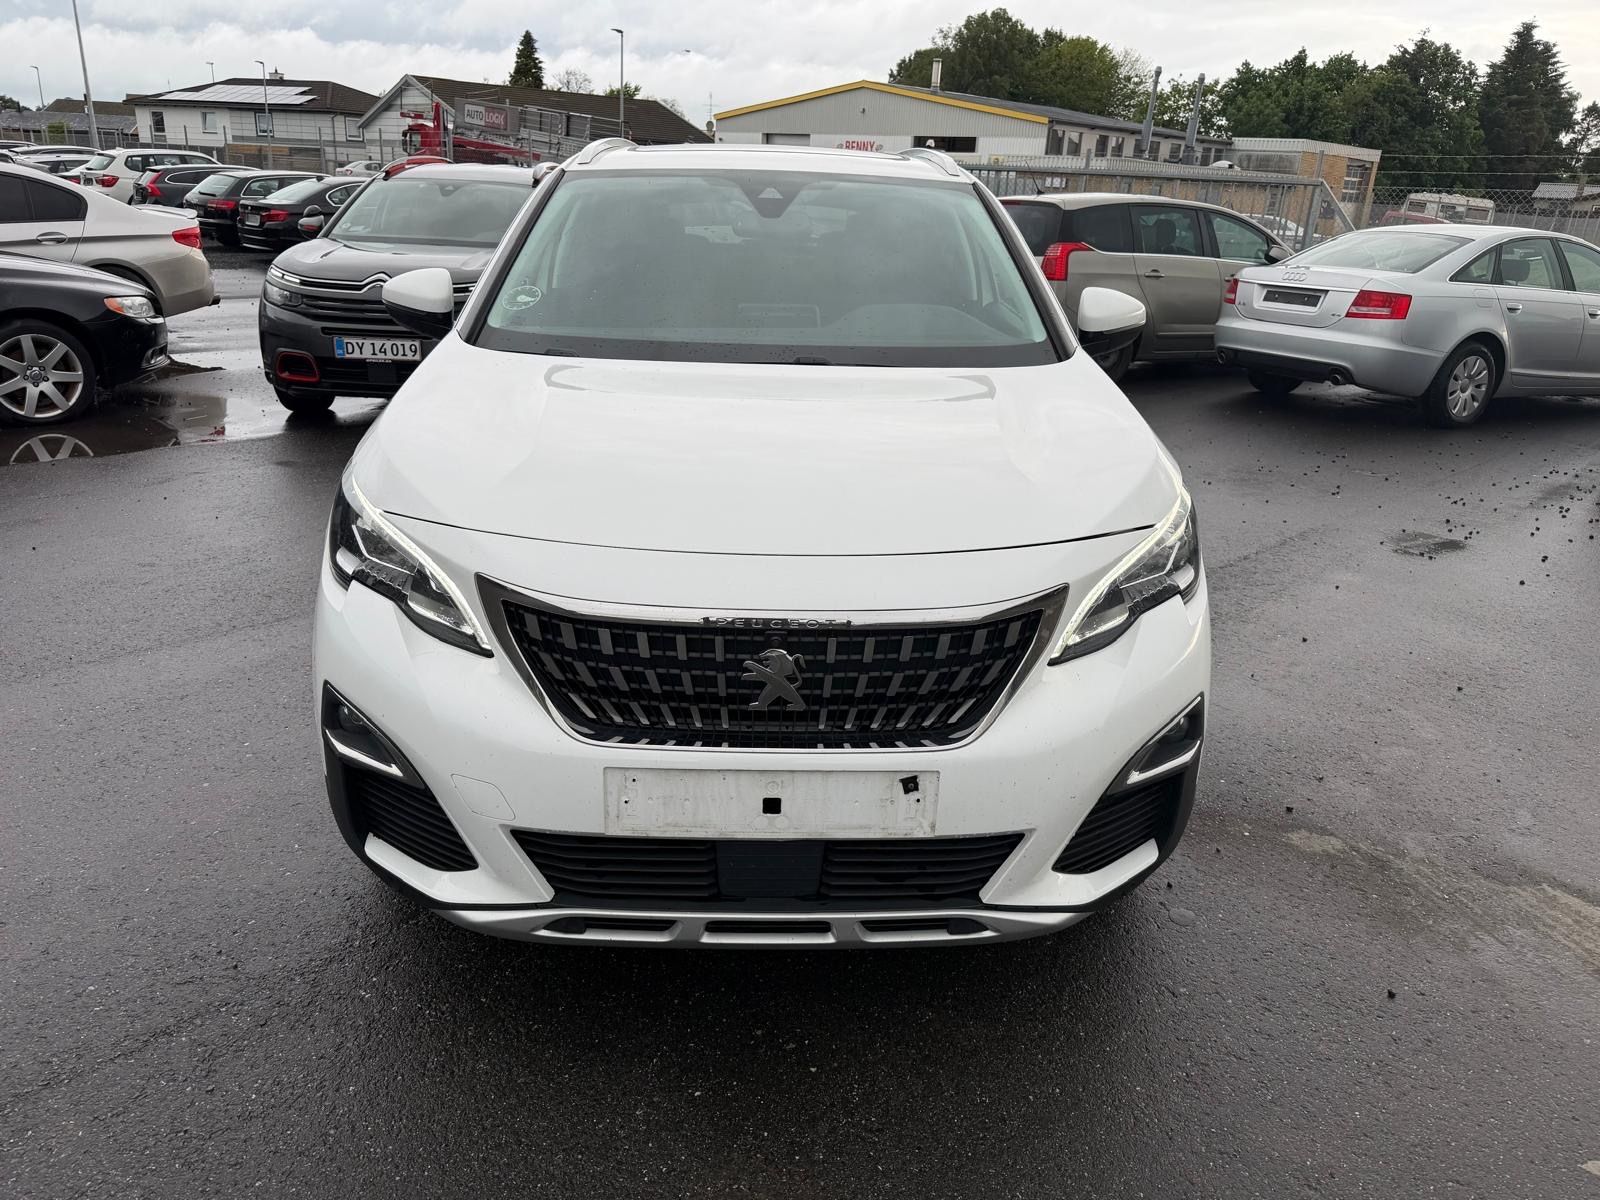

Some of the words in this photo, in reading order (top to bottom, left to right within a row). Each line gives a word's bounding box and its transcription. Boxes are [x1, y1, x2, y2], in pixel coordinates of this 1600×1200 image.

[466, 109, 484, 121] AUTO
[345, 341, 365, 355] DY
[716, 618, 836, 629] PEUGEOT
